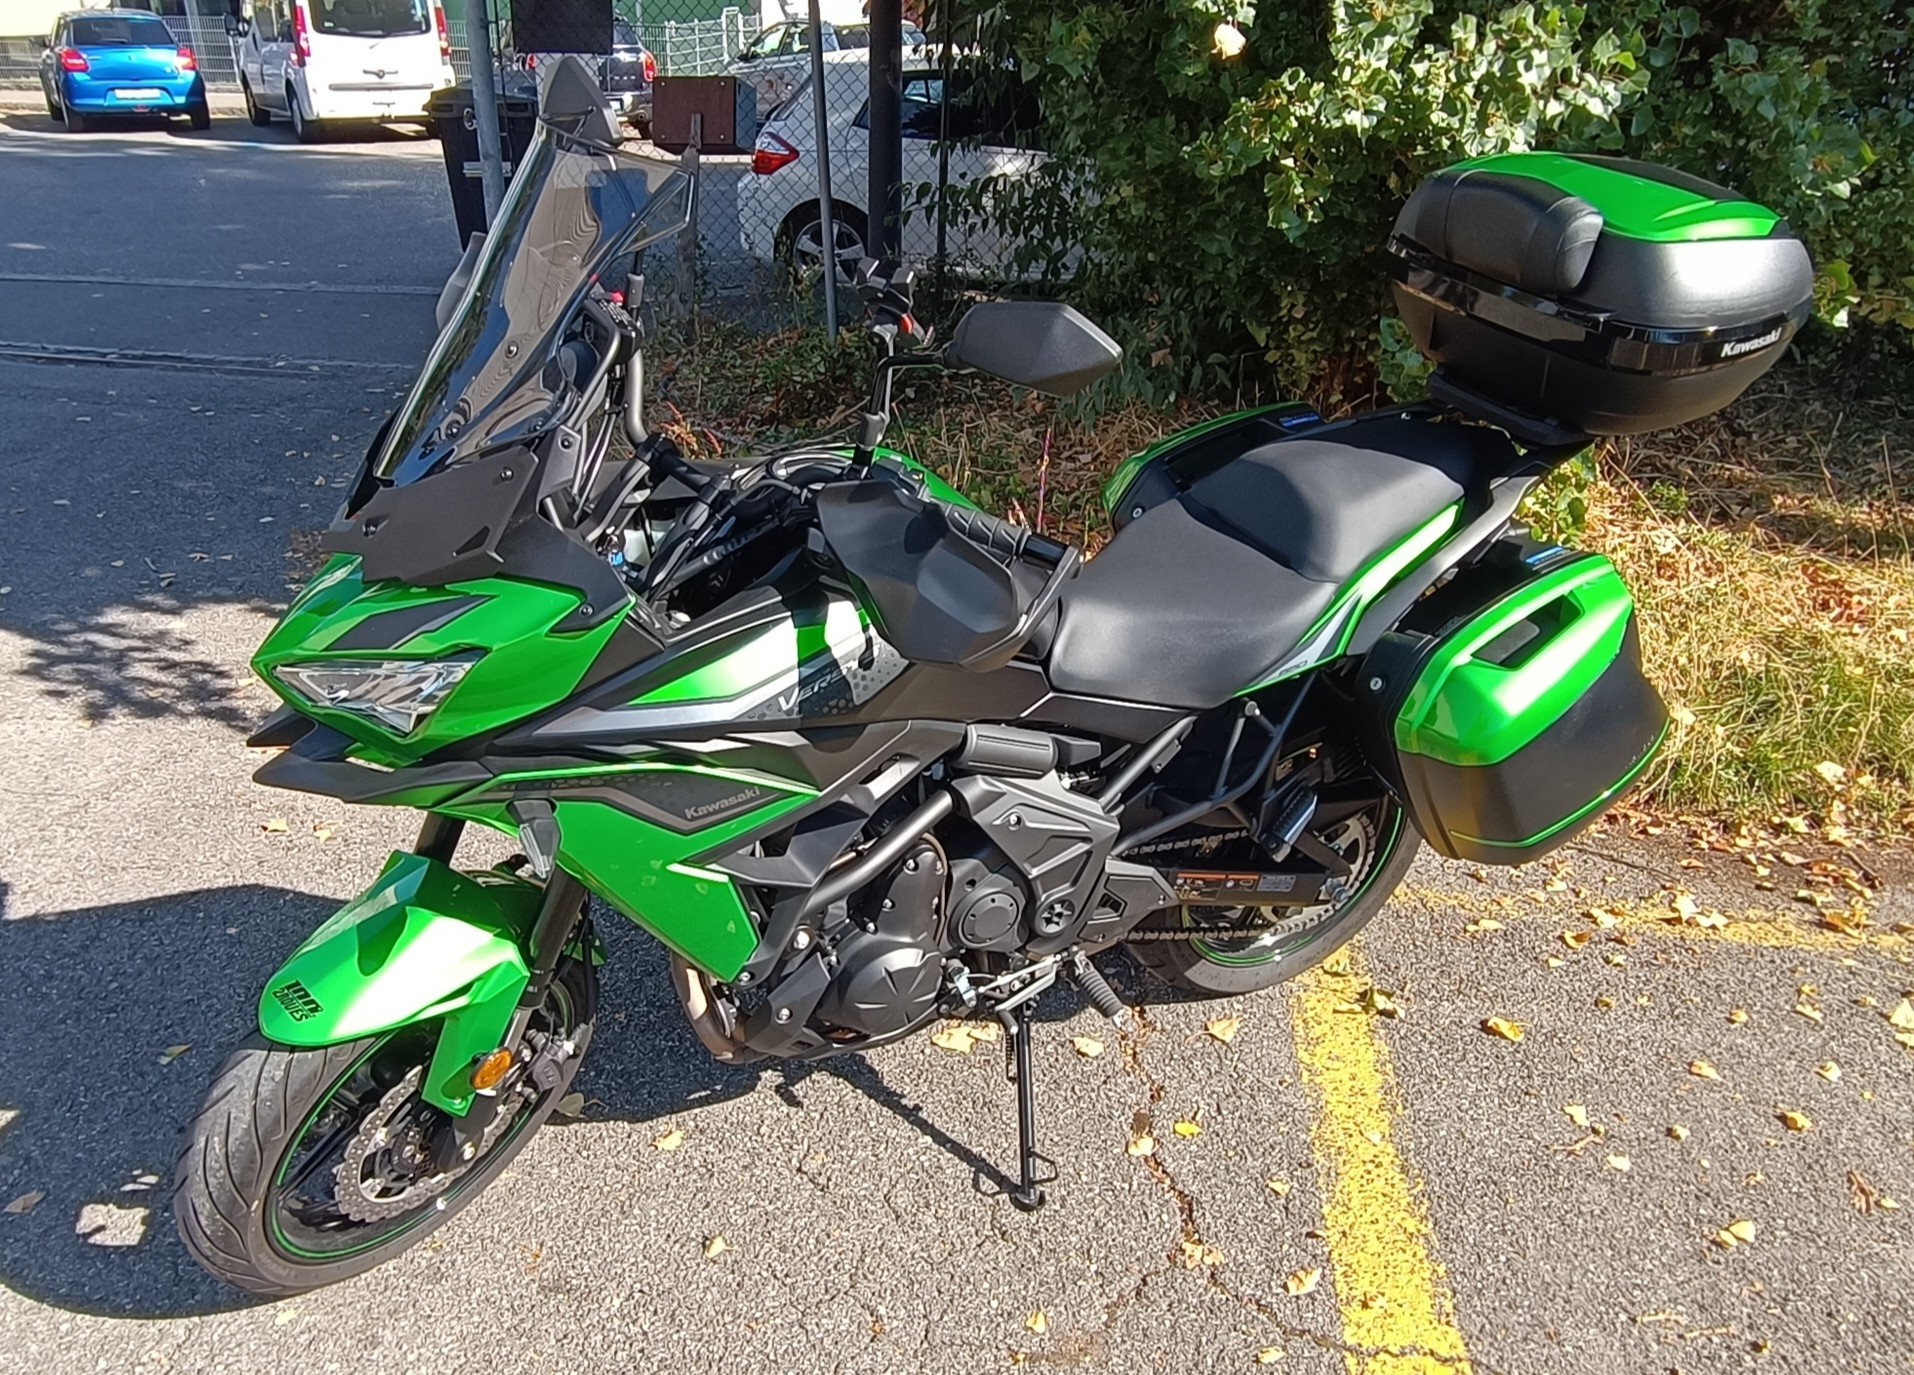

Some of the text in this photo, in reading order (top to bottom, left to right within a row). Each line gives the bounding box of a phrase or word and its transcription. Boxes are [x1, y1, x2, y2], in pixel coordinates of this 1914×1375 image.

[1720, 326, 1782, 357] Kawasaki
[778, 643, 880, 711] VERSY
[684, 786, 760, 819] Kawasaki
